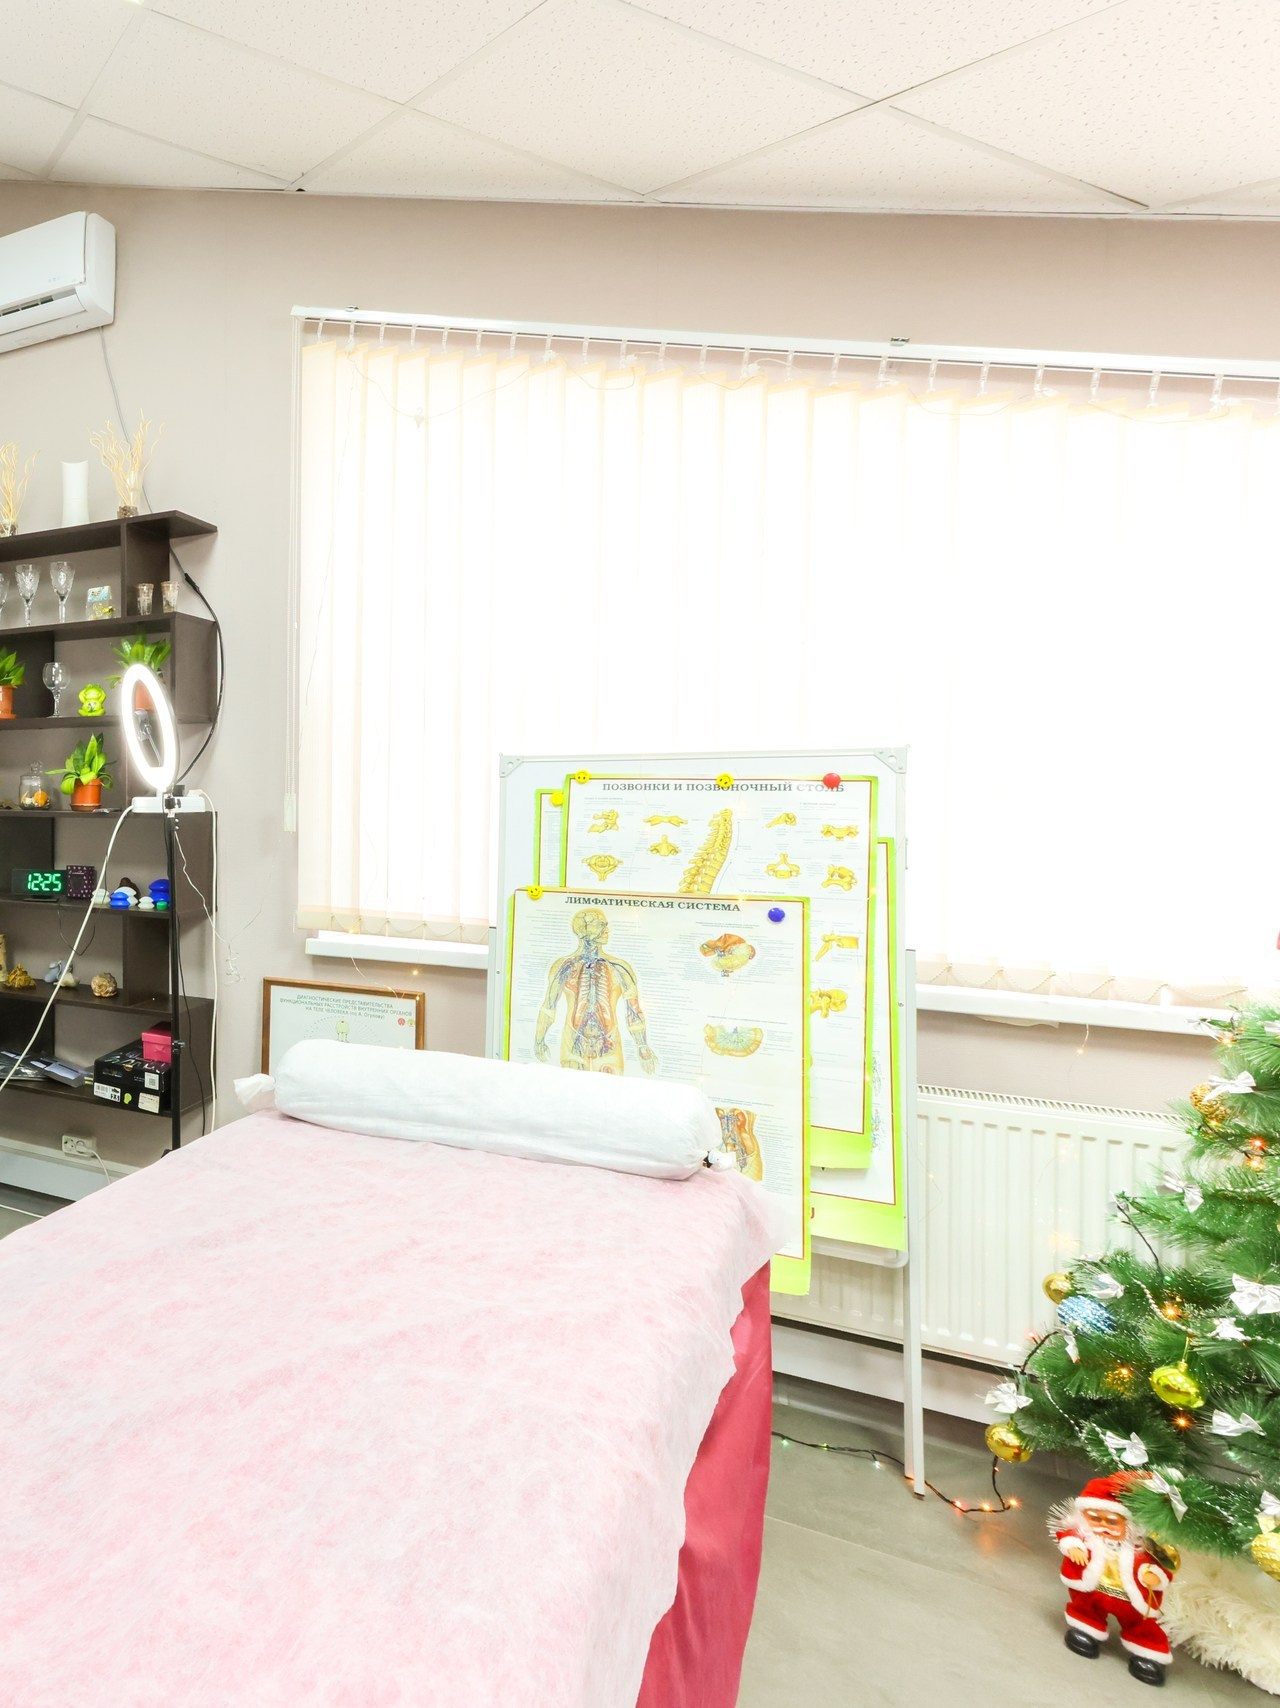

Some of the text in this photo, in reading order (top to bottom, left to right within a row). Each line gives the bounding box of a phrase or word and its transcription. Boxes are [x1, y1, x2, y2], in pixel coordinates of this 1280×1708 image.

[602, 782, 670, 791] ПОЗВОНКИ
[673, 782, 683, 791] И
[686, 781, 792, 792] ПОЗВОНОЧНЫЙ
[27, 872, 62, 892] 12:25
[565, 896, 741, 912] ЛИМФАТИЧЕСКАЯ СИСТЕМА
